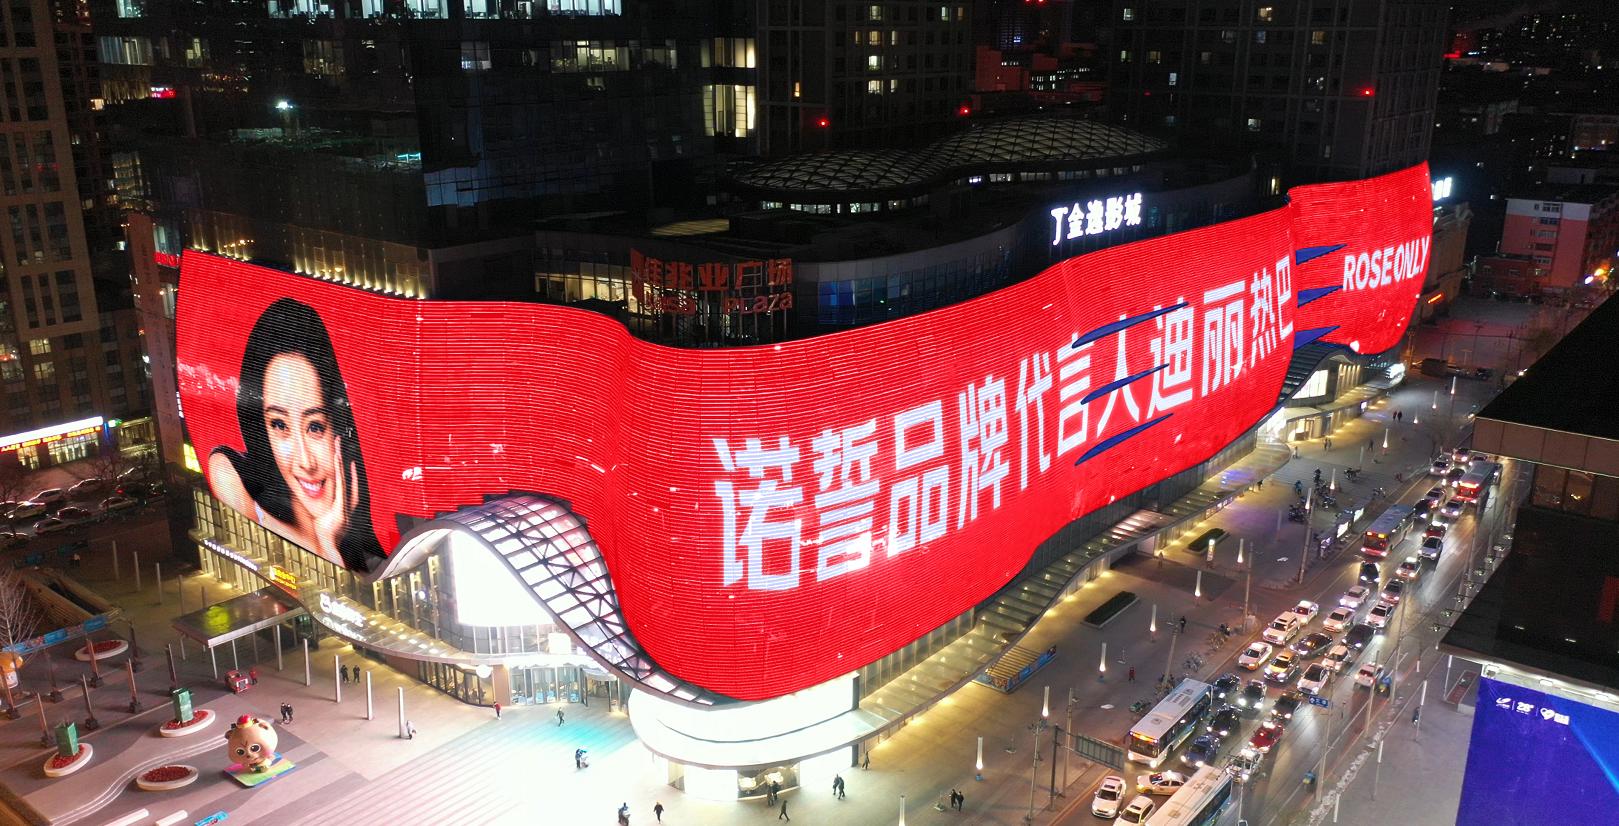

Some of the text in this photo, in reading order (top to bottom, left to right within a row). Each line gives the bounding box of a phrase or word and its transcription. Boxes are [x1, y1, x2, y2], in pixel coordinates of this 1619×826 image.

[713, 254, 1294, 592] 诺誓品牌代言人迪丽热巴
